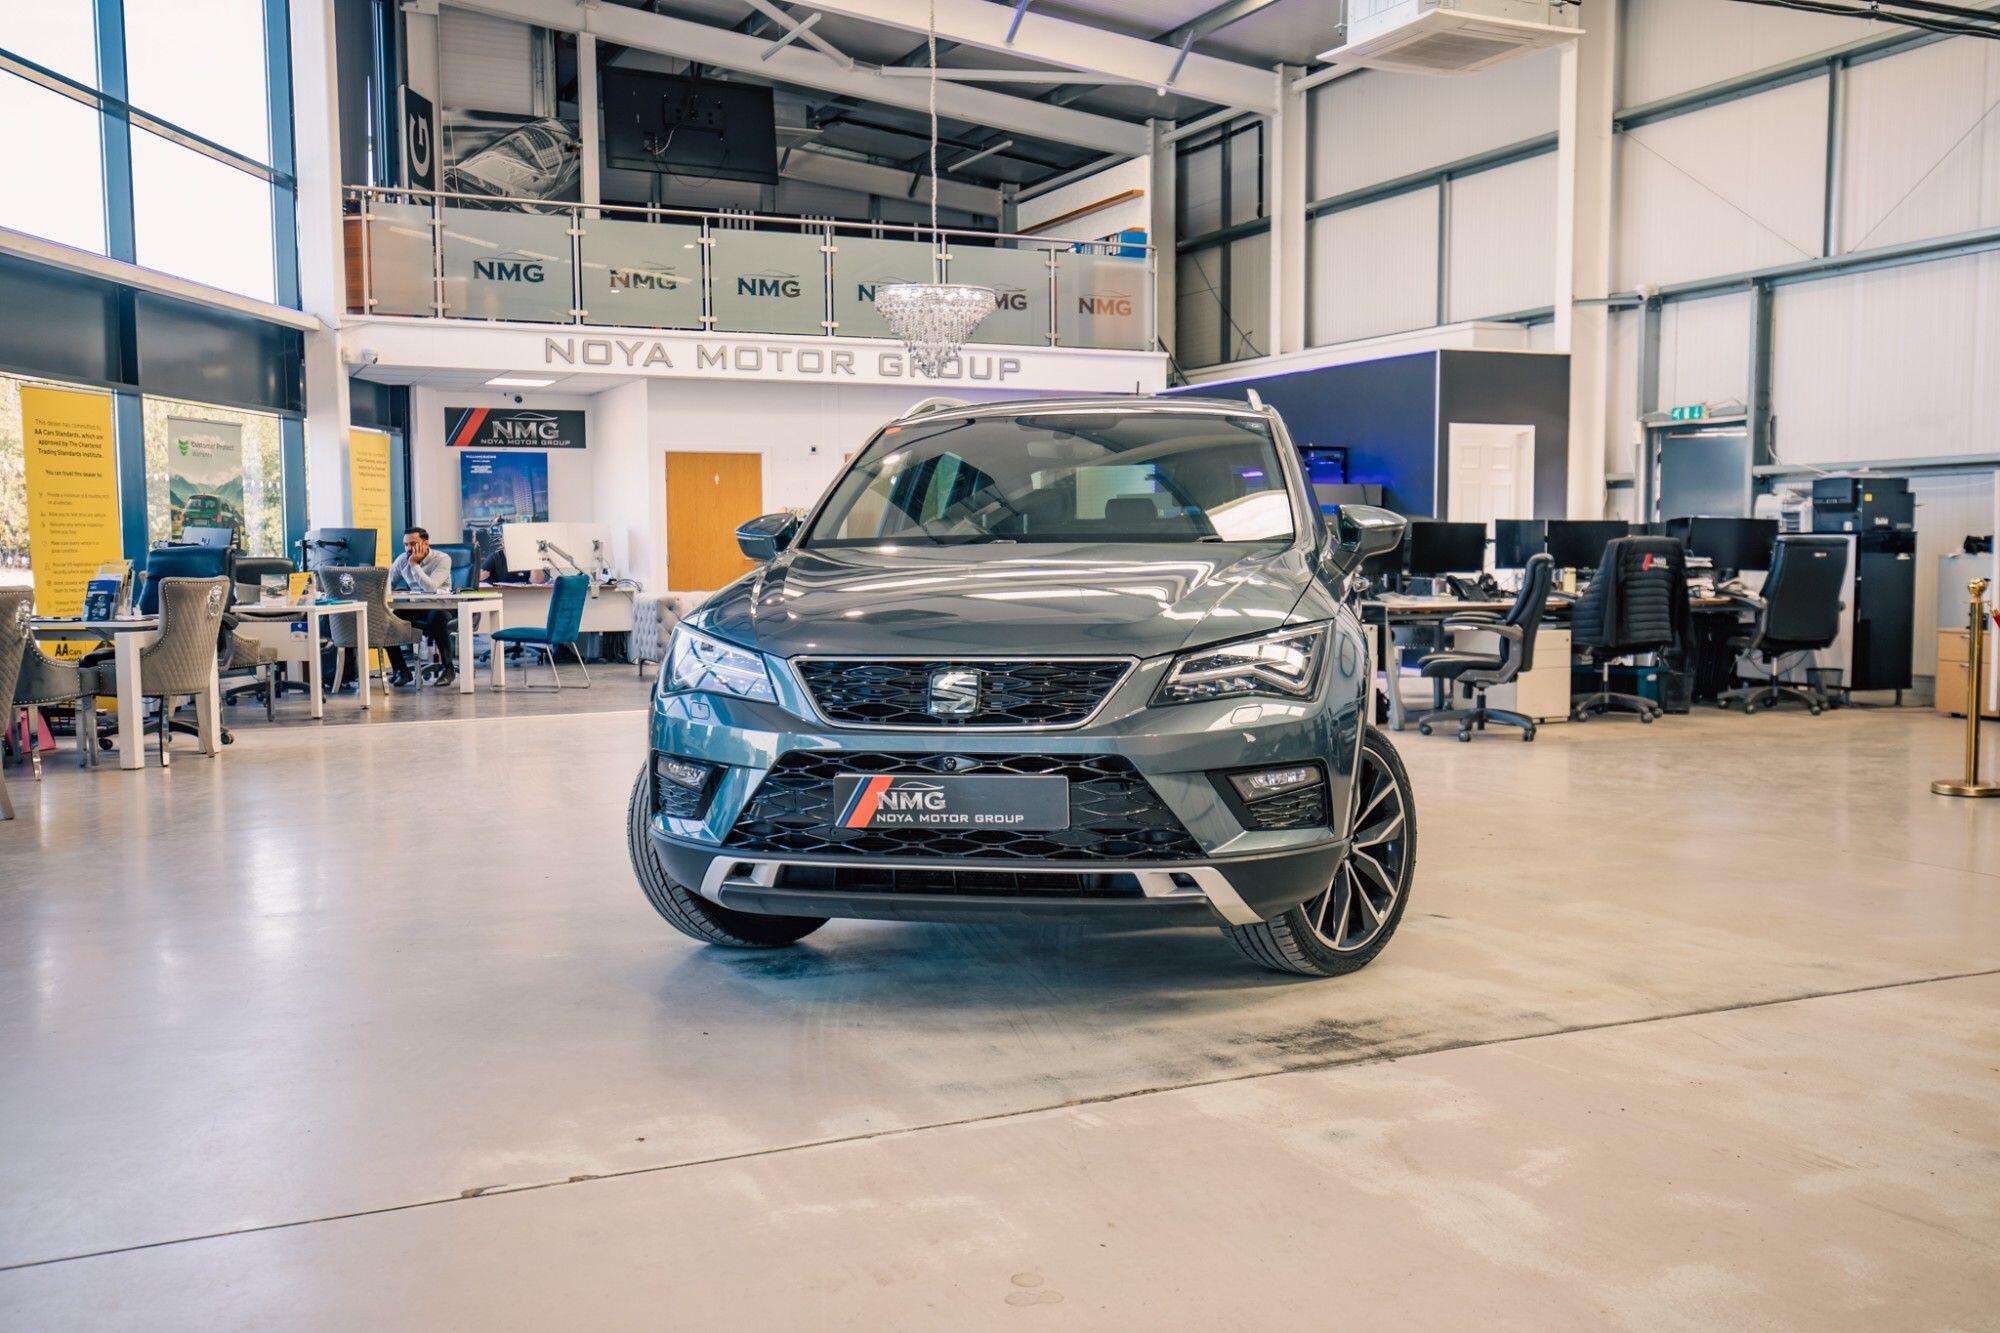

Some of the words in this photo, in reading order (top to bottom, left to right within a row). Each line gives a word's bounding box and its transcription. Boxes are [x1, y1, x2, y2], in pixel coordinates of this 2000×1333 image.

[473, 260, 545, 283] NMG
[610, 268, 677, 291] NMG
[737, 277, 801, 298] NMG
[994, 292, 1027, 311] MG
[1078, 297, 1132, 316] NMG
[545, 337, 674, 368] NOYA
[696, 344, 856, 375] MOTOR
[492, 420, 560, 440] NMG
[55, 643, 69, 657] AA
[877, 791, 946, 810] NMG
[876, 813, 914, 823] NOYA
[919, 814, 969, 823] MOTOR
[974, 814, 1024, 823] GROUP
